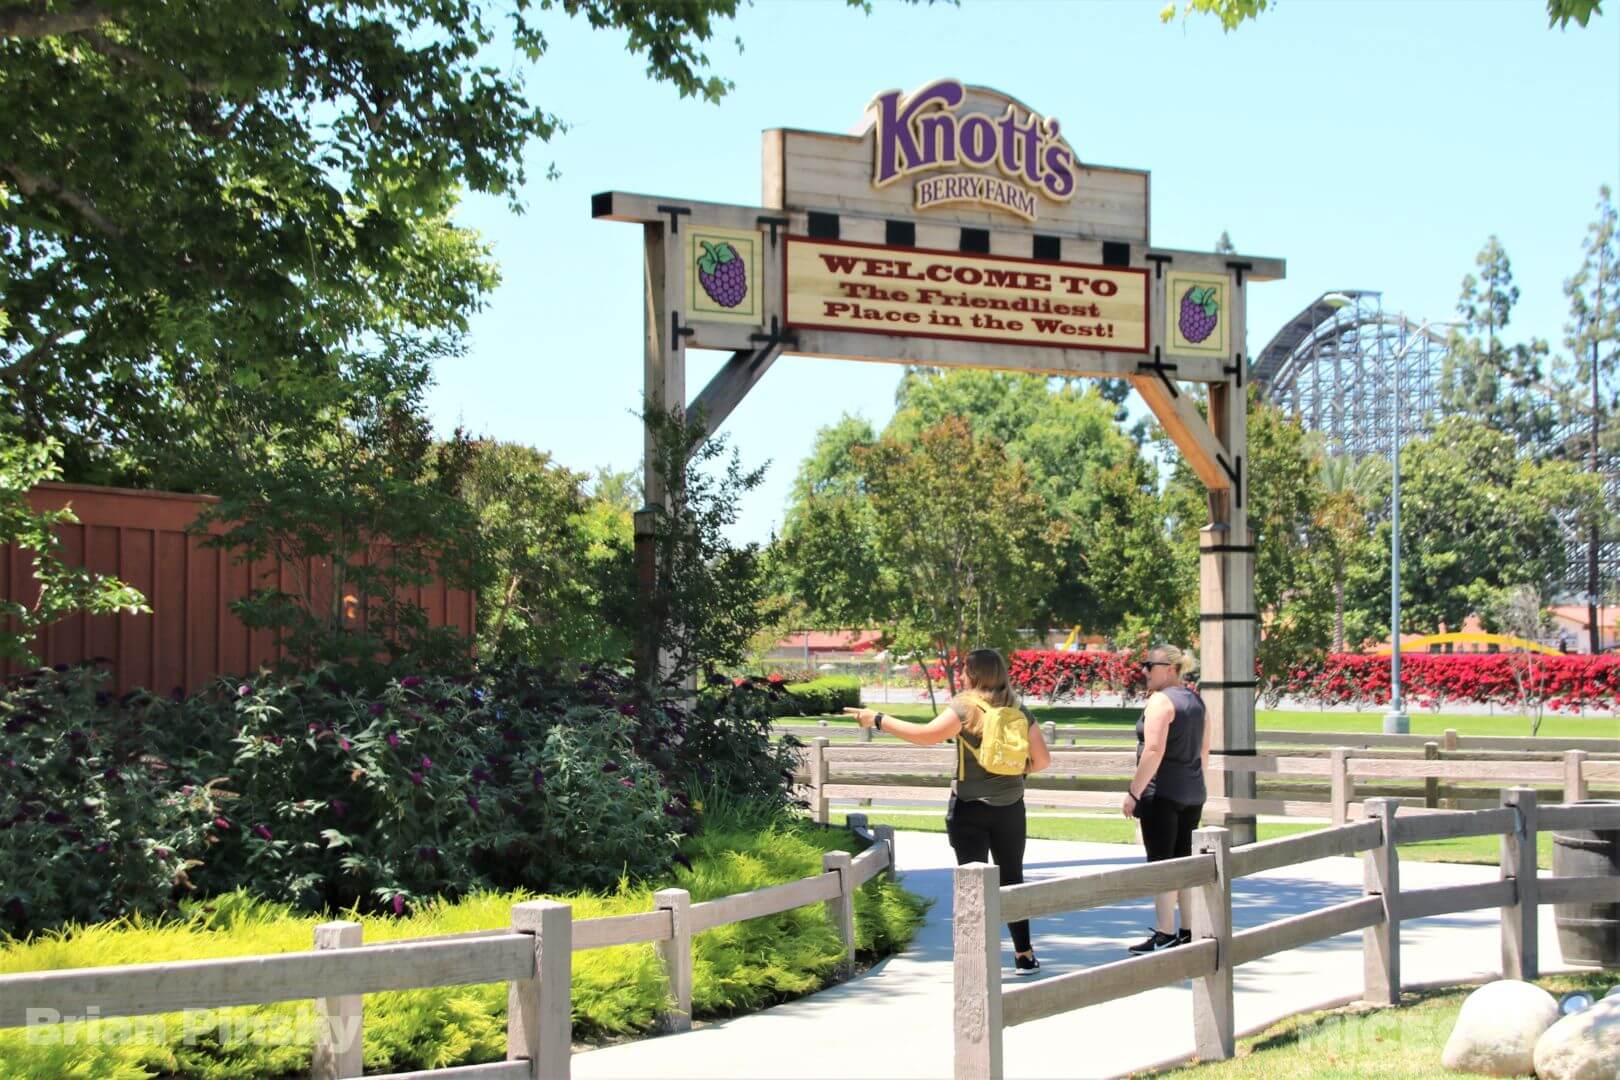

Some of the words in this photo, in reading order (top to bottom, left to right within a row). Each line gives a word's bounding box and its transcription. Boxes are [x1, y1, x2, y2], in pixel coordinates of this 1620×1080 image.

[875, 80, 1074, 196] Knott's
[920, 177, 981, 205] BERRY
[984, 179, 1036, 217] FARM
[819, 253, 1052, 292] WELCOME
[1060, 276, 1118, 297] TO
[839, 281, 909, 302] The
[916, 288, 1100, 318] Friendliest
[823, 301, 921, 324] Place
[928, 309, 962, 327] in
[970, 313, 1024, 331] the
[1031, 318, 1114, 339] West!
